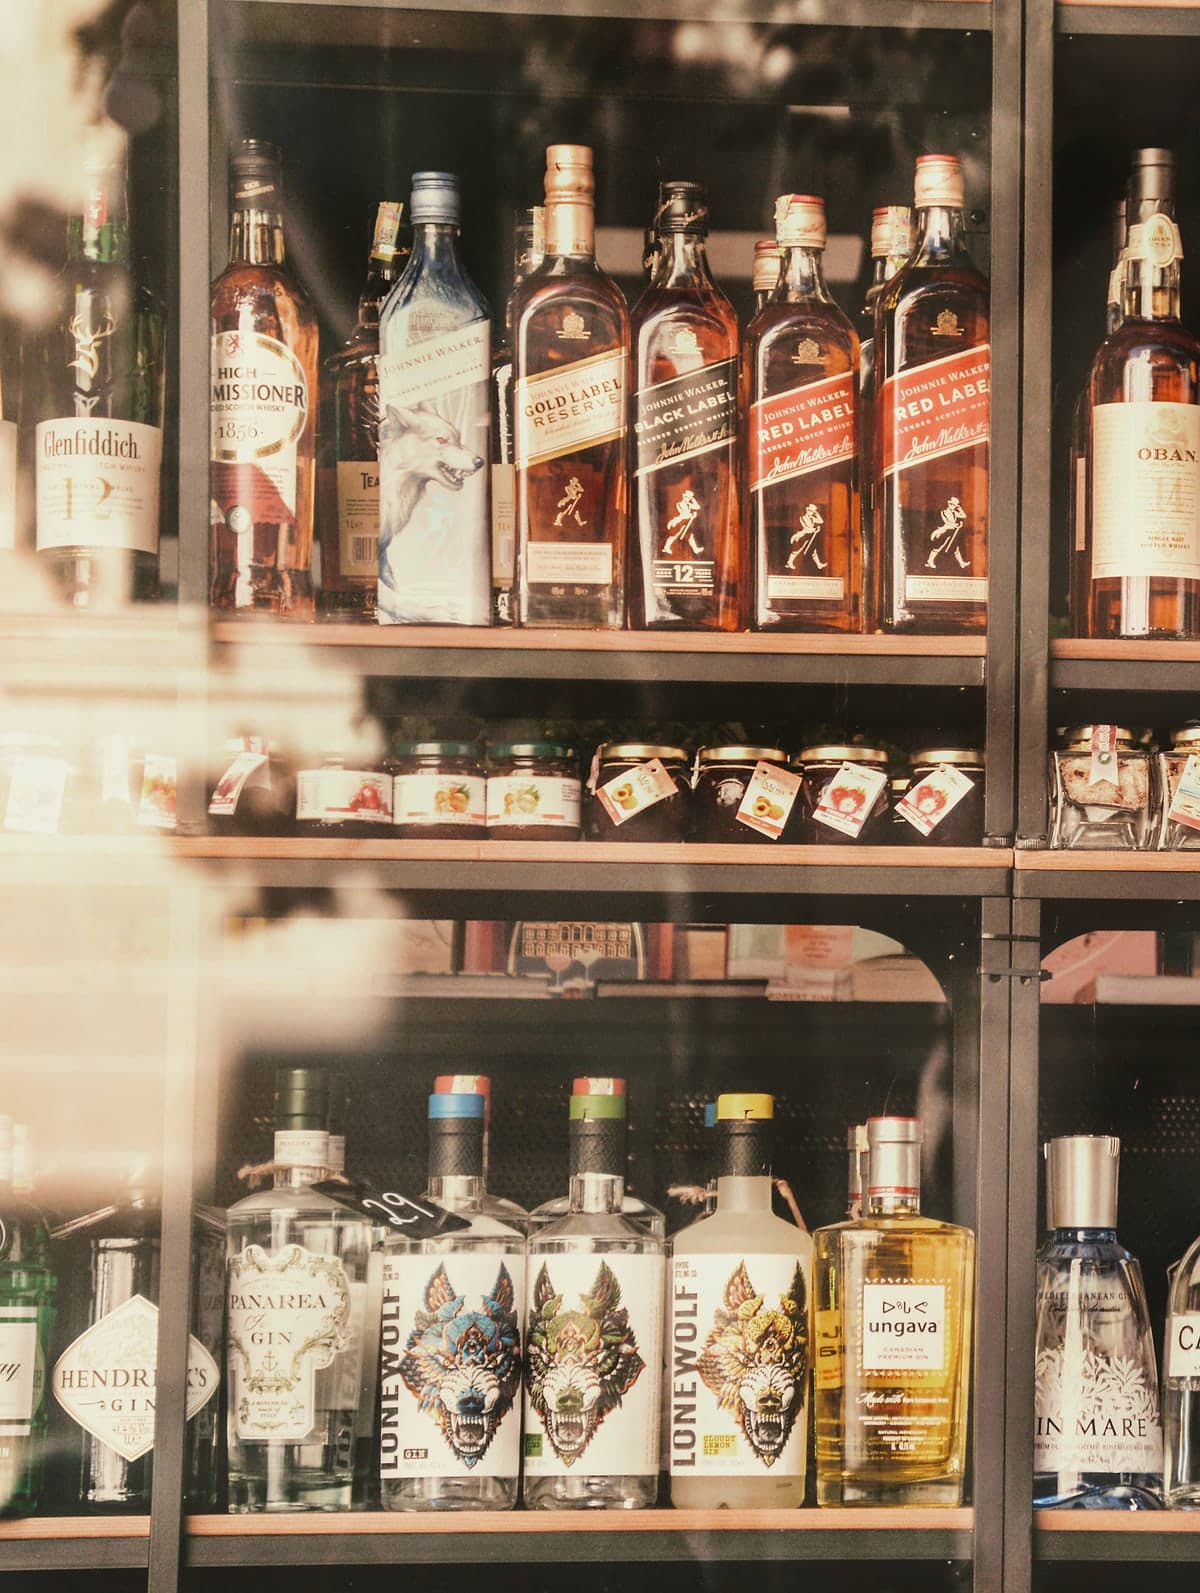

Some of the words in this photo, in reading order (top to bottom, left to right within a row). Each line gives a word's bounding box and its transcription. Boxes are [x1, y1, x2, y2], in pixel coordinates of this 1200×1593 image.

[218, 367, 257, 380] HIGH
[211, 383, 305, 408] MISSIONER
[525, 395, 567, 417] GOLD
[570, 378, 622, 403] LABEL
[900, 375, 947, 401] JOHNNIE
[534, 393, 620, 428] RESERVE
[634, 408, 685, 433] BLACK
[687, 391, 736, 415] LABEL
[639, 393, 685, 415] JOHNNIE
[763, 402, 806, 425] JOHNNIE
[894, 397, 934, 422] RED
[757, 422, 795, 443] RED
[798, 402, 854, 430] LABEL
[1137, 447, 1196, 463] OBAN
[673, 564, 694, 583] 12
[231, 1294, 328, 1310] PANAREA
[251, 1332, 293, 1345] GIN
[868, 1319, 938, 1337] ungava
[380, 1287, 400, 1471] LONEWOLF
[672, 1284, 698, 1468] LONEWOLF
[1073, 1416, 1148, 1438] MARE
[405, 1449, 426, 1459] GIN
